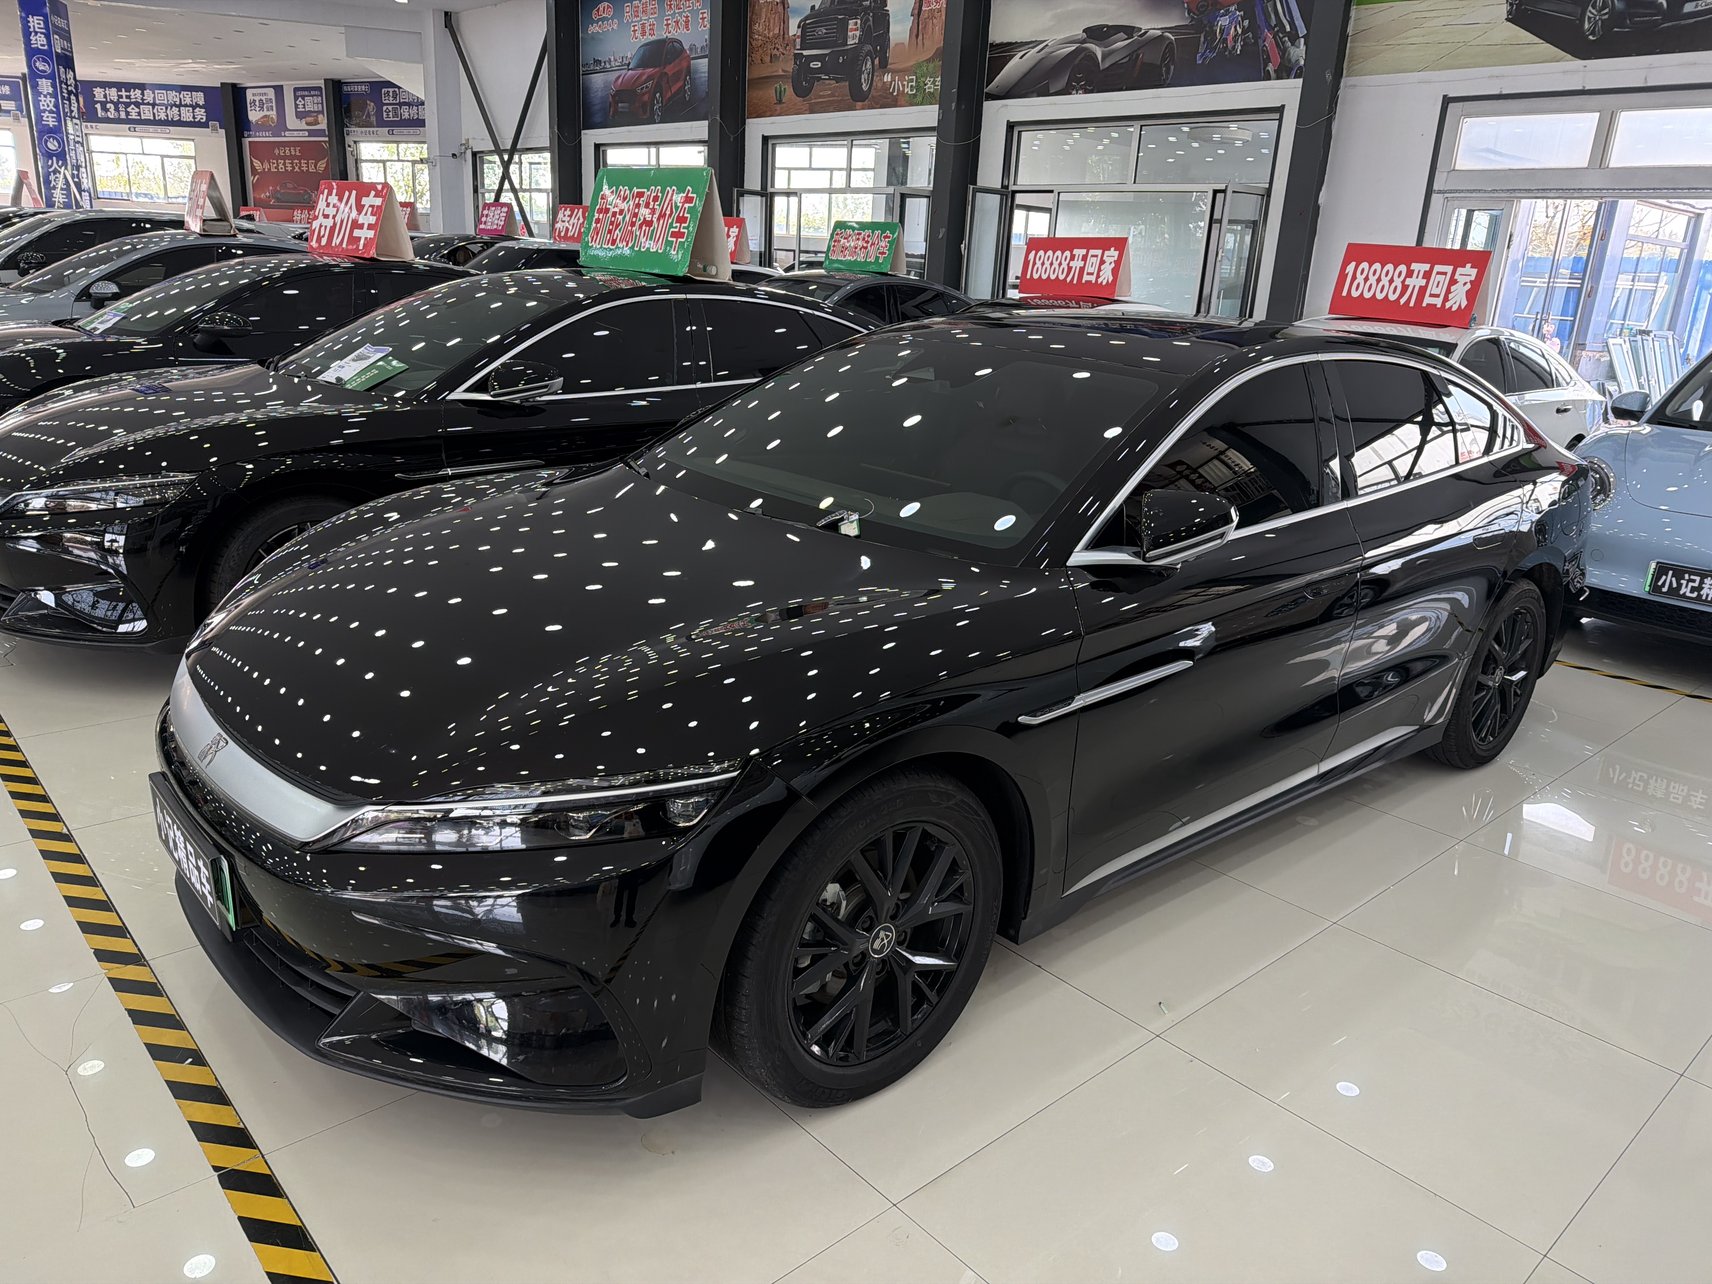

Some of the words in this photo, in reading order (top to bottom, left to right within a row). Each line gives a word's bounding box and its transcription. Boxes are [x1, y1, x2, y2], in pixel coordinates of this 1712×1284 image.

[624, 0, 658, 23] 只做精品
[631, 20, 657, 42] 无事故
[663, 12, 691, 37] 无水淹
[698, 9, 708, 31] 无
[27, 14, 48, 50] 拒绝
[36, 78, 58, 128] 事故车
[92, 86, 206, 106] 查博士终身回购保障
[249, 98, 265, 112] 终身
[296, 96, 314, 111] 全国
[262, 160, 316, 172] 小记名车交车区
[274, 147, 301, 156] 小记名车汇
[48, 156, 68, 209] 火烧车
[311, 188, 383, 250] 特价车
[555, 207, 586, 238] 特价
[589, 185, 697, 254] 新能源特价车
[724, 225, 740, 251] 家
[829, 228, 893, 263] 新能源特价车
[1026, 246, 1120, 286] 18888开回家
[1341, 260, 1478, 311] 18888开回家
[156, 797, 213, 908] 小记精品车
